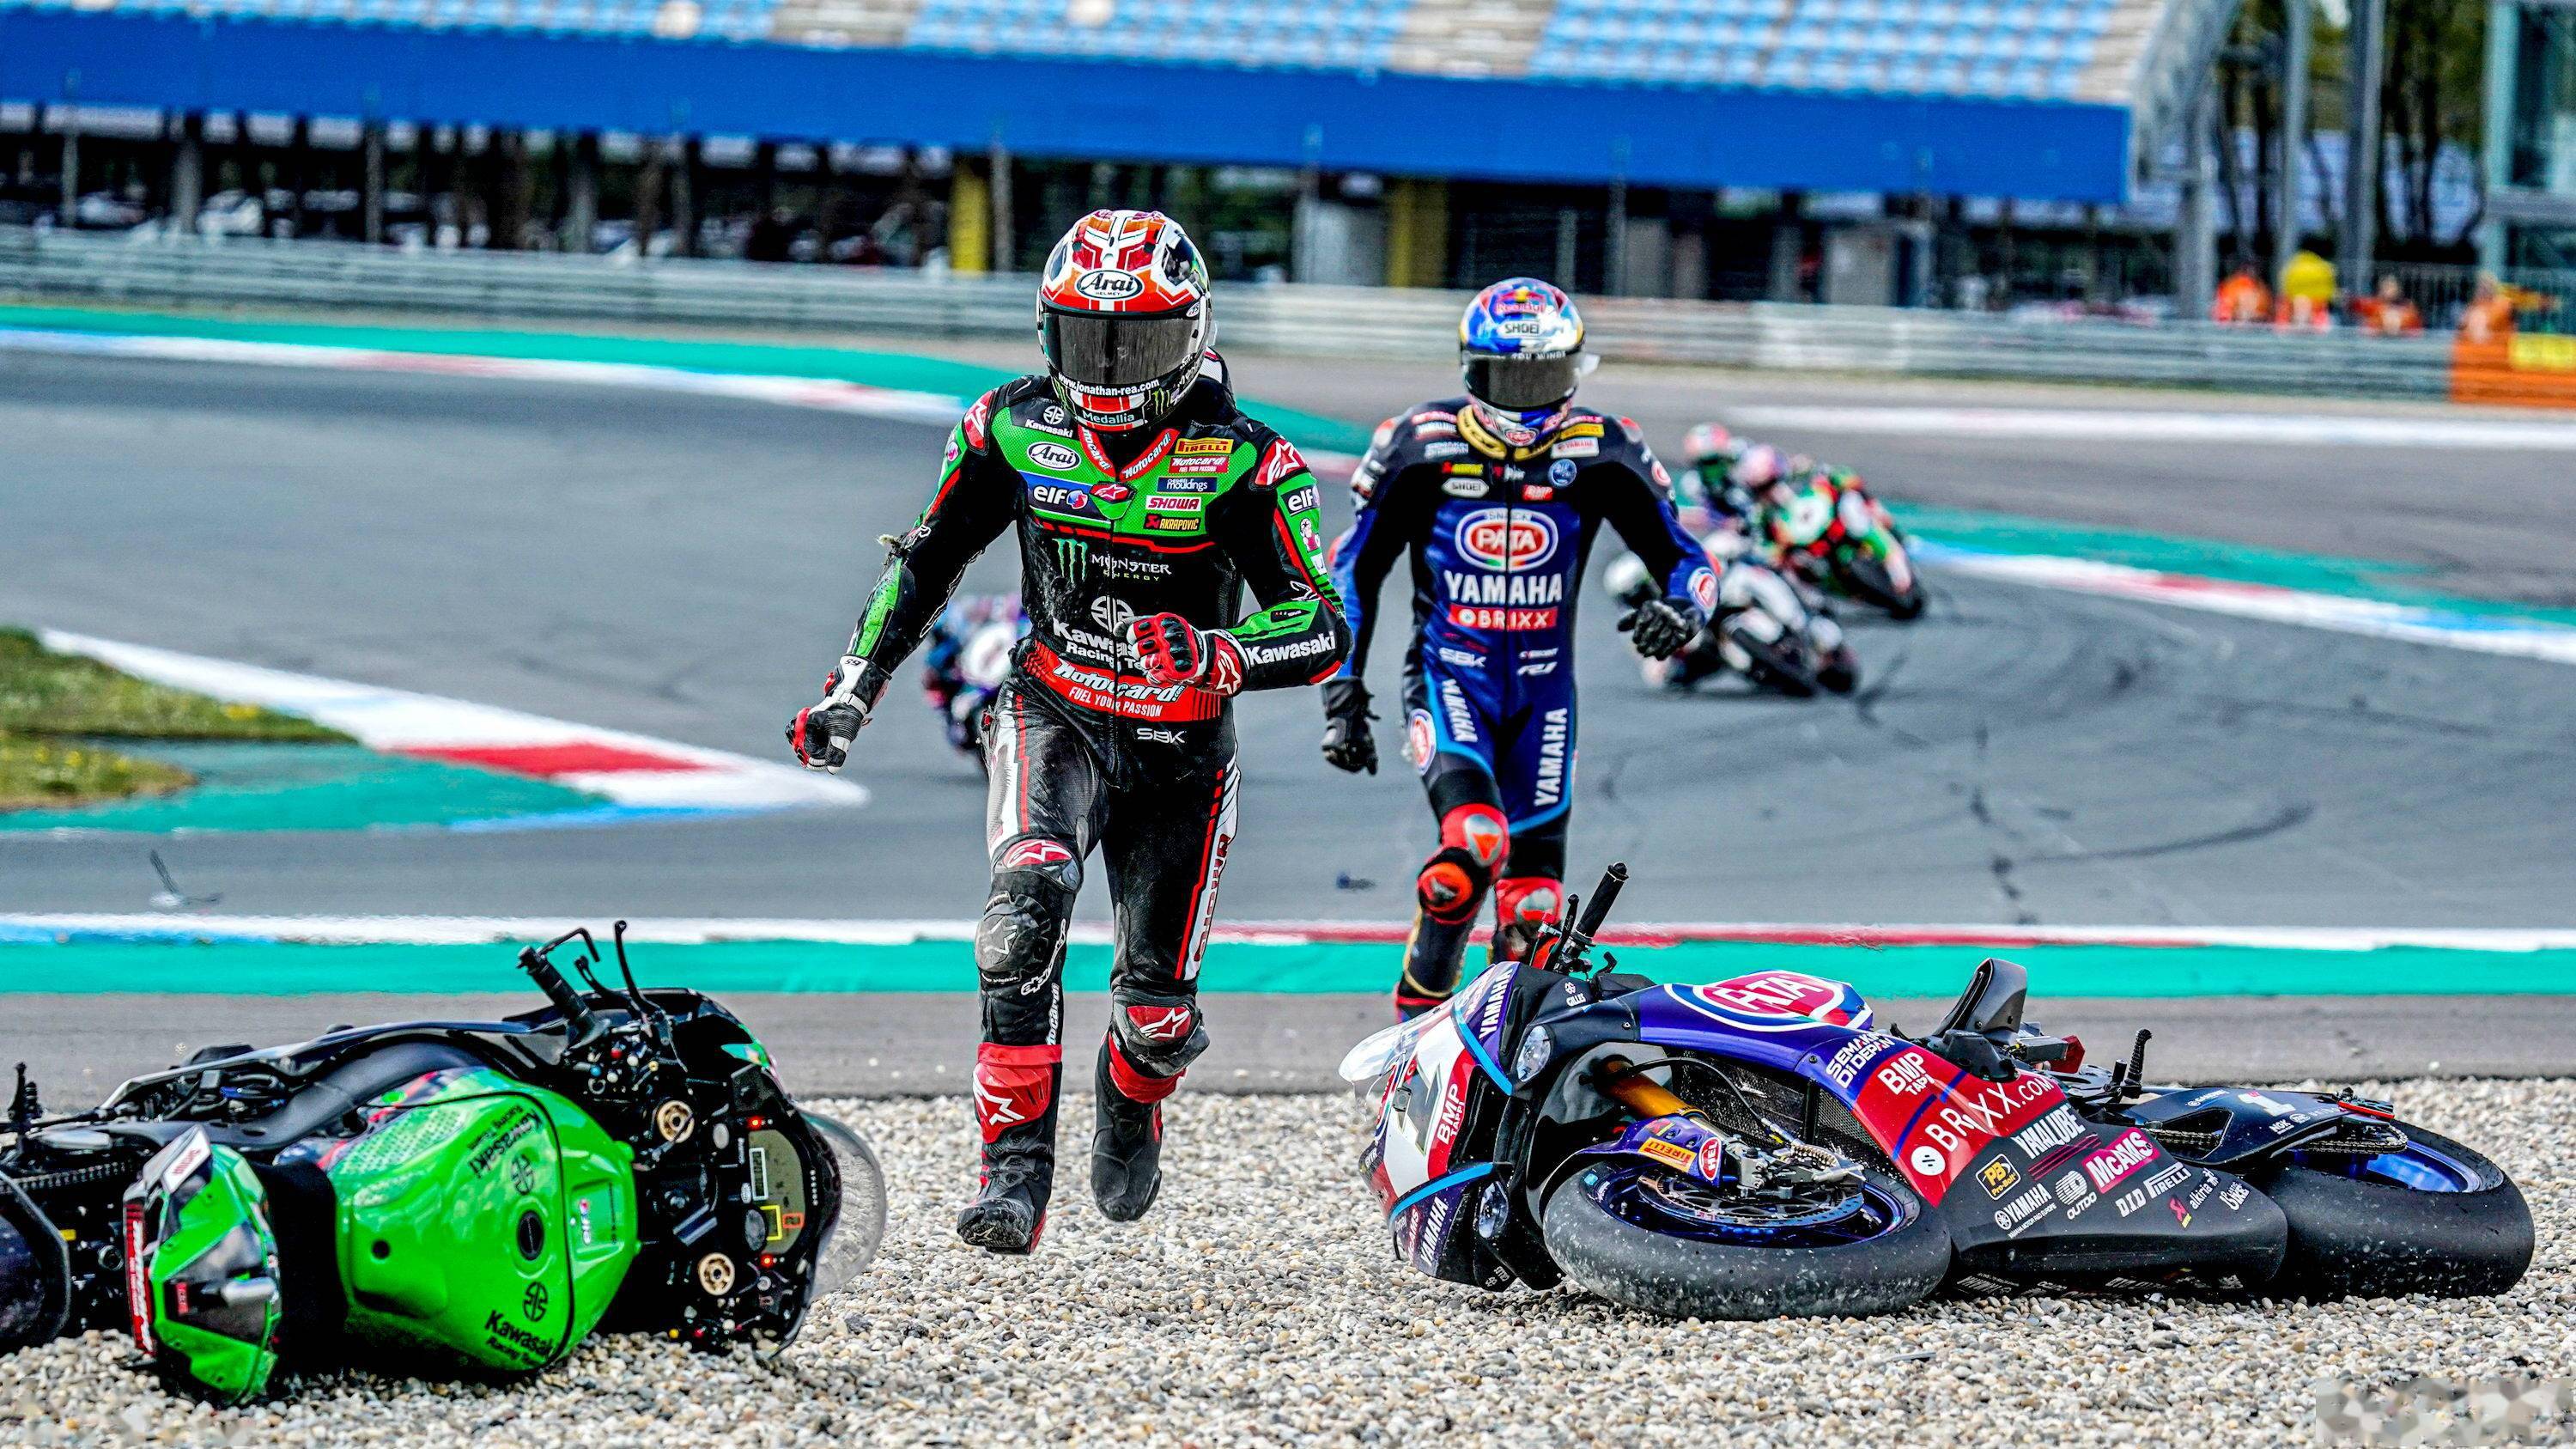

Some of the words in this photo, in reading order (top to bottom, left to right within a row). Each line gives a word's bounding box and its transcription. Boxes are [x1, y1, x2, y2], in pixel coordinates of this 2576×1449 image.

[1078, 272, 1135, 292] Arai
[1504, 323, 1540, 334] SHOEI
[1058, 373, 1160, 397] www.jonathan-rea.com
[1024, 418, 1073, 439] Kawasaki
[1082, 410, 1135, 424] Medallia
[1031, 446, 1074, 465] Arai
[1177, 440, 1229, 452] PIRELLI
[1033, 485, 1067, 505] elf
[1166, 479, 1208, 492] mouldings
[1147, 497, 1200, 509] SHOWA
[1287, 489, 1315, 511] elf
[1476, 527, 1537, 551] PATA
[1091, 553, 1172, 575] MONSTER
[1103, 569, 1160, 581] ENERGY
[1443, 569, 1563, 606] YAMAHA
[1052, 617, 1136, 658] Kawas
[1246, 630, 1336, 667] Kawasaki
[1066, 640, 1121, 672] Racing
[1068, 685, 1091, 704] FUEL
[1093, 693, 1121, 712] YOUR
[1122, 701, 1163, 718] PASSION
[1136, 727, 1187, 744] SBK
[1534, 708, 1568, 807] YAMAHA
[1478, 968, 1514, 1039] YAMAHA
[1826, 1030, 1882, 1079] SEMAKIN
[1850, 1037, 1895, 1078] DEPAN
[1877, 1051, 1925, 1096] BMP
[1437, 1083, 1461, 1145] BMP
[1643, 1140, 1692, 1167] PIRELLI
[1707, 1141, 1719, 1172] HEL
[2085, 1130, 2154, 1189] McAMS
[1984, 1161, 2007, 1186] PB
[1991, 1172, 2016, 1196] Pro-Bolt
[2143, 1161, 2192, 1199] PIRELLI
[2002, 1182, 2053, 1223] YAMAHA
[2041, 1202, 2057, 1217] EUROPE
[2066, 1191, 2098, 1221] OUTDO
[1419, 1195, 1448, 1267] YAMAHA
